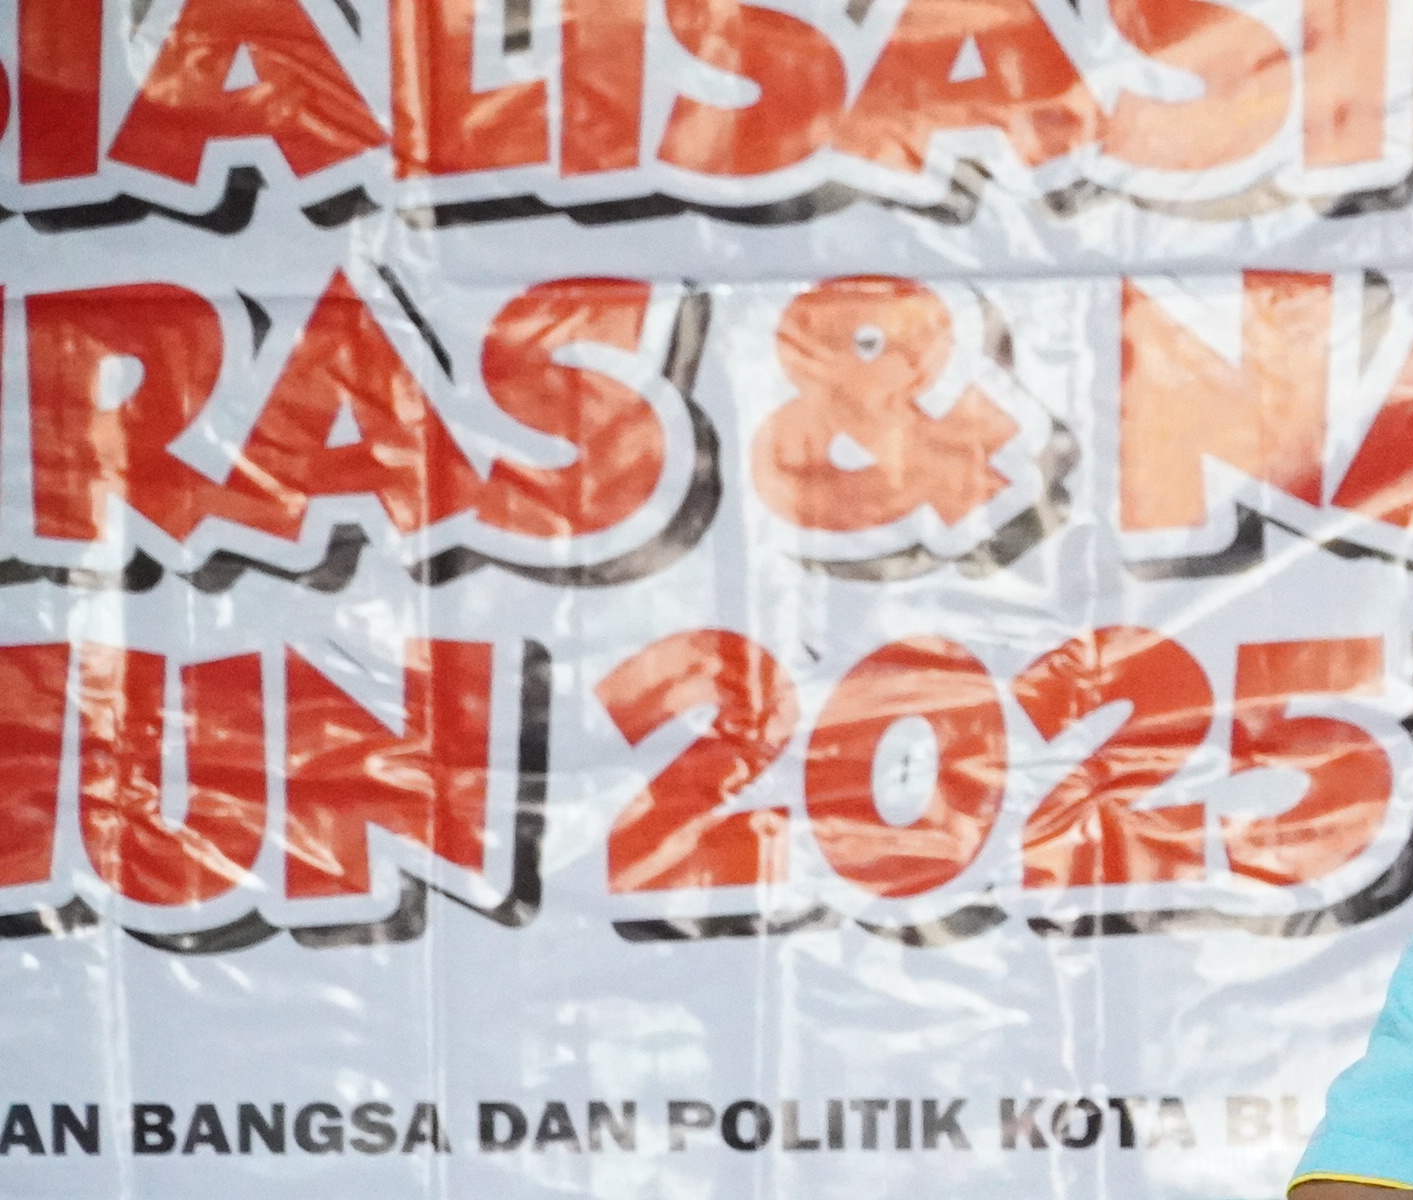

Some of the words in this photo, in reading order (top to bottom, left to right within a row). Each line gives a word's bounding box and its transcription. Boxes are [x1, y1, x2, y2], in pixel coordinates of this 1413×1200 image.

[0, 0, 1390, 190] IALISASI
[0, 262, 668, 546] RAS
[750, 274, 1022, 536] &
[592, 624, 1396, 900] 2025
[132, 1100, 452, 1156] BANGSA
[477, 1098, 635, 1155] DAN
[665, 1095, 973, 1154] POLITIK
[999, 1095, 1197, 1151] KOTA
